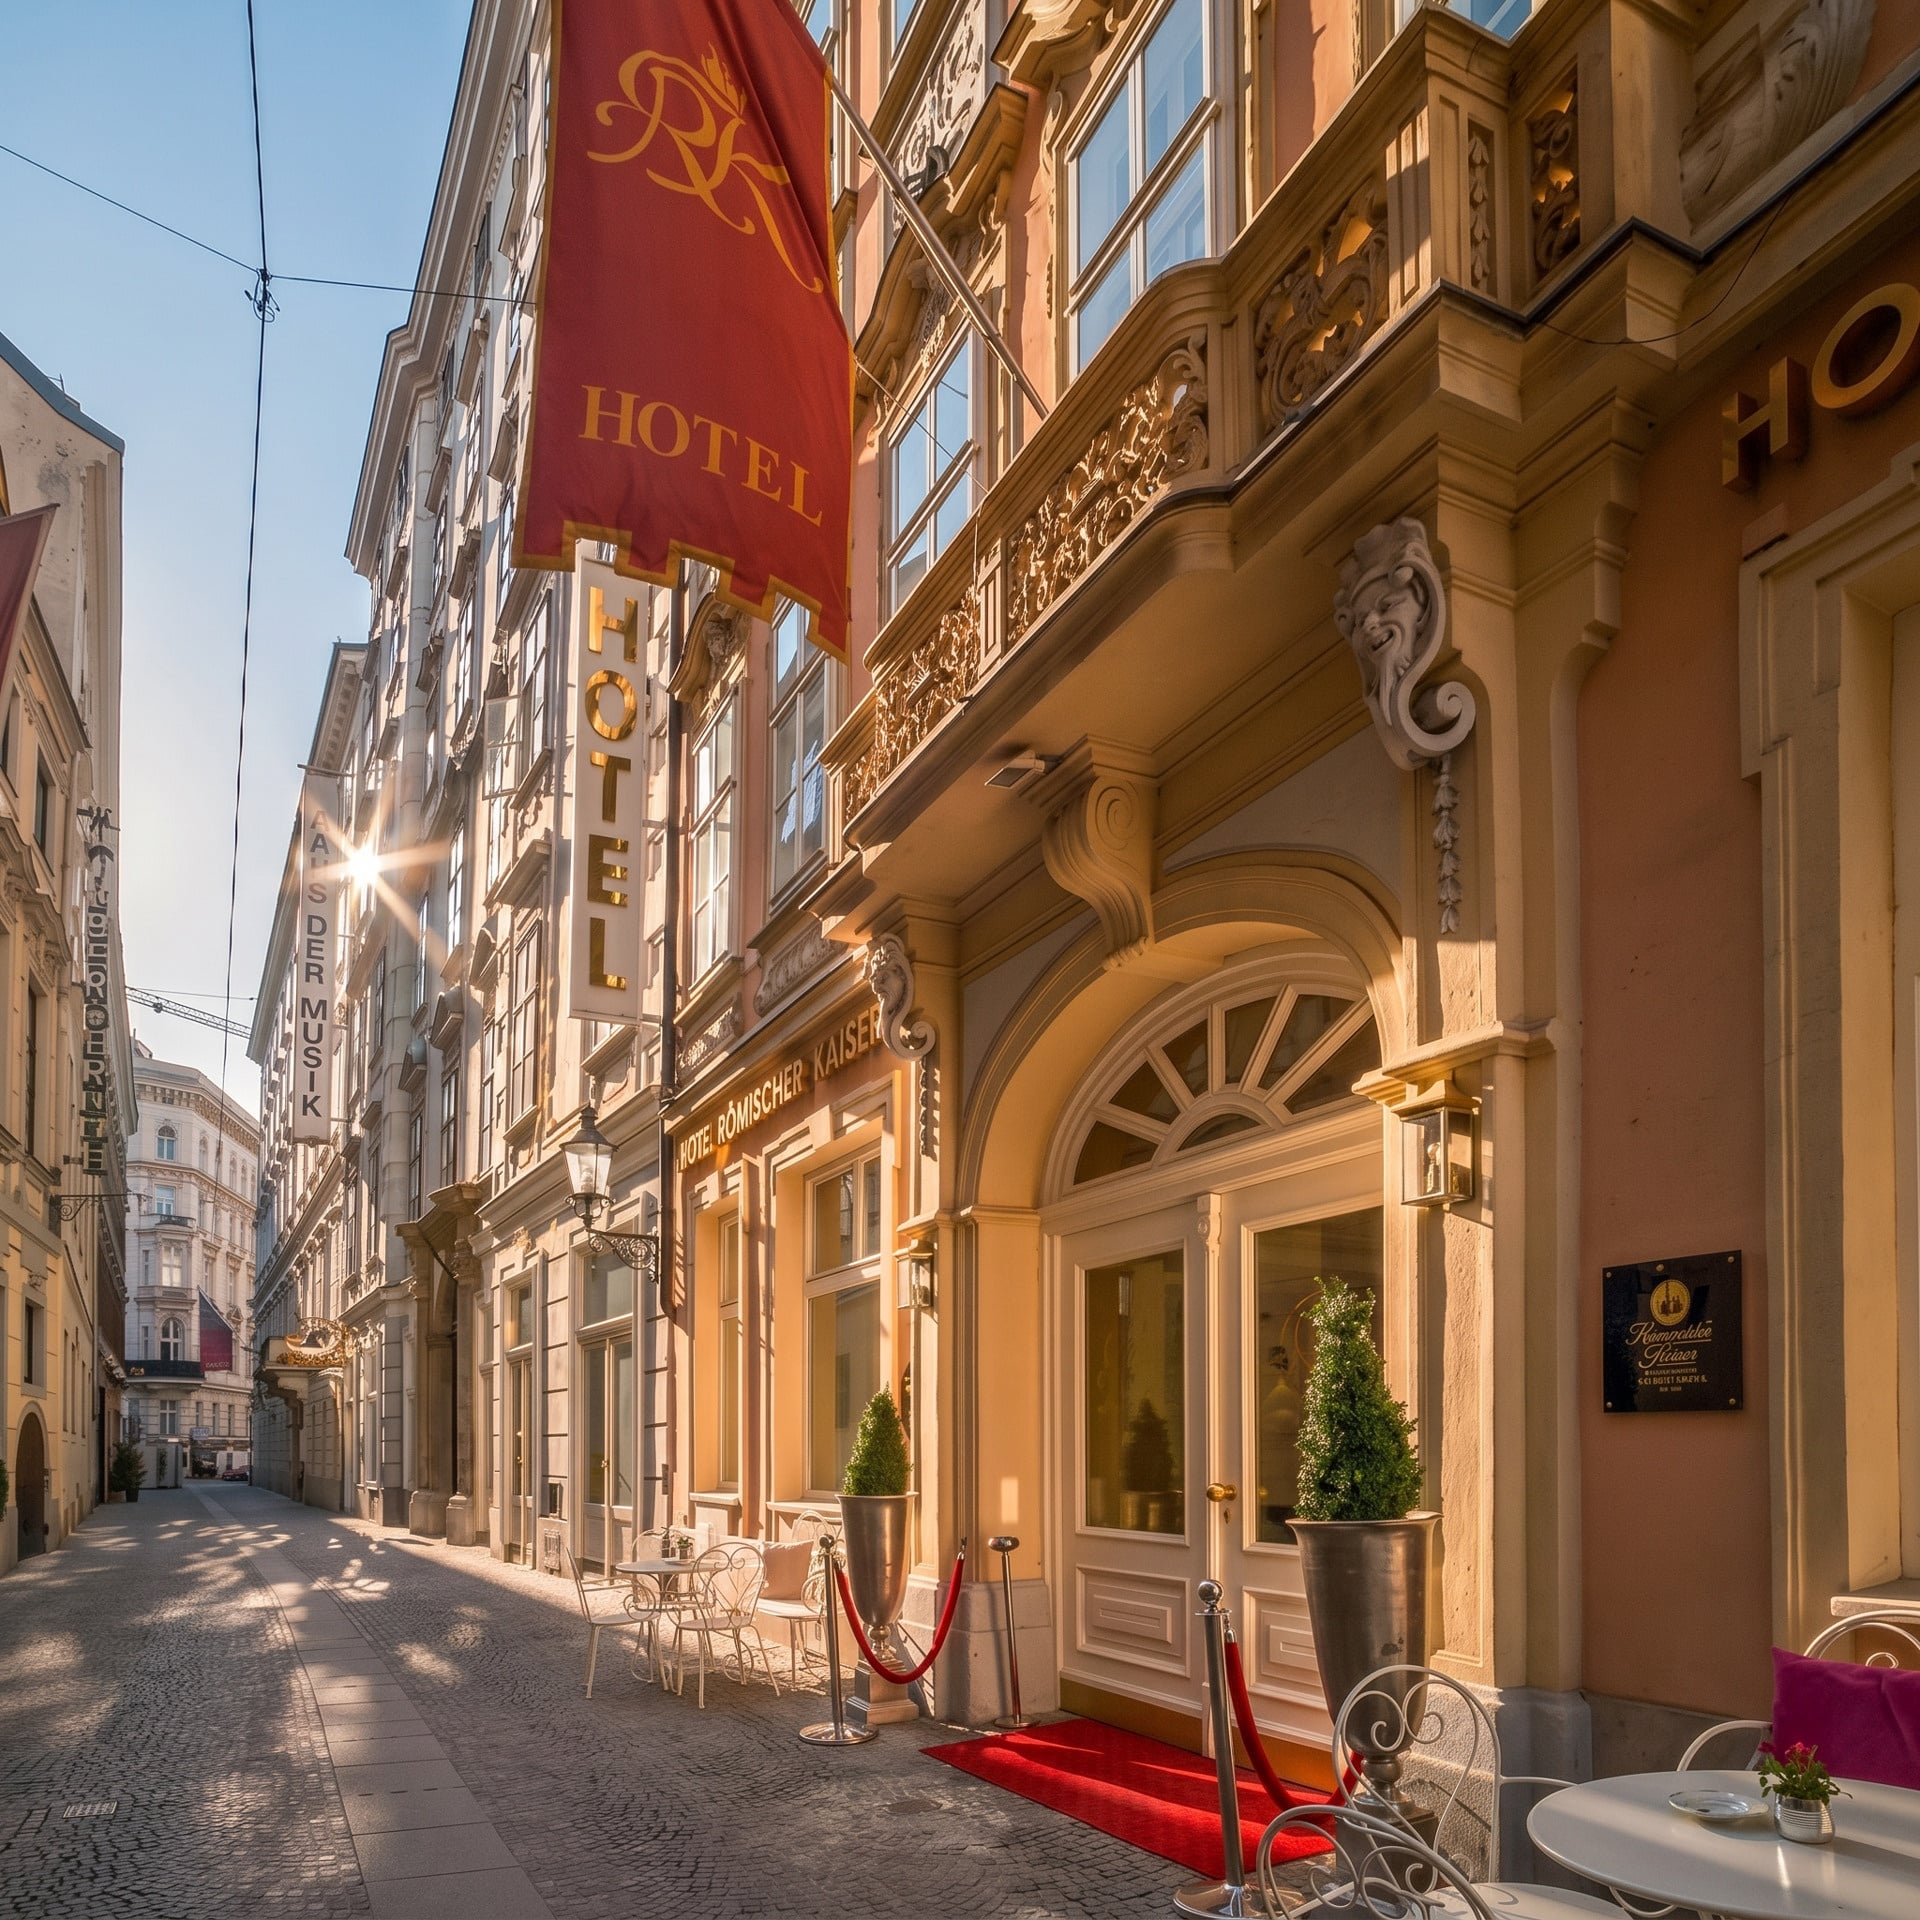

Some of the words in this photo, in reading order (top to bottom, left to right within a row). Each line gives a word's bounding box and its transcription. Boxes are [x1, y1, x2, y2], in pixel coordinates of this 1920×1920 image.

[1721, 283, 1920, 488] HO
[579, 384, 823, 526] HOTEL
[585, 586, 638, 990] HOTEL
[305, 914, 328, 985] DER
[300, 997, 328, 1118] MUSIK
[814, 1002, 881, 1081] KAISER
